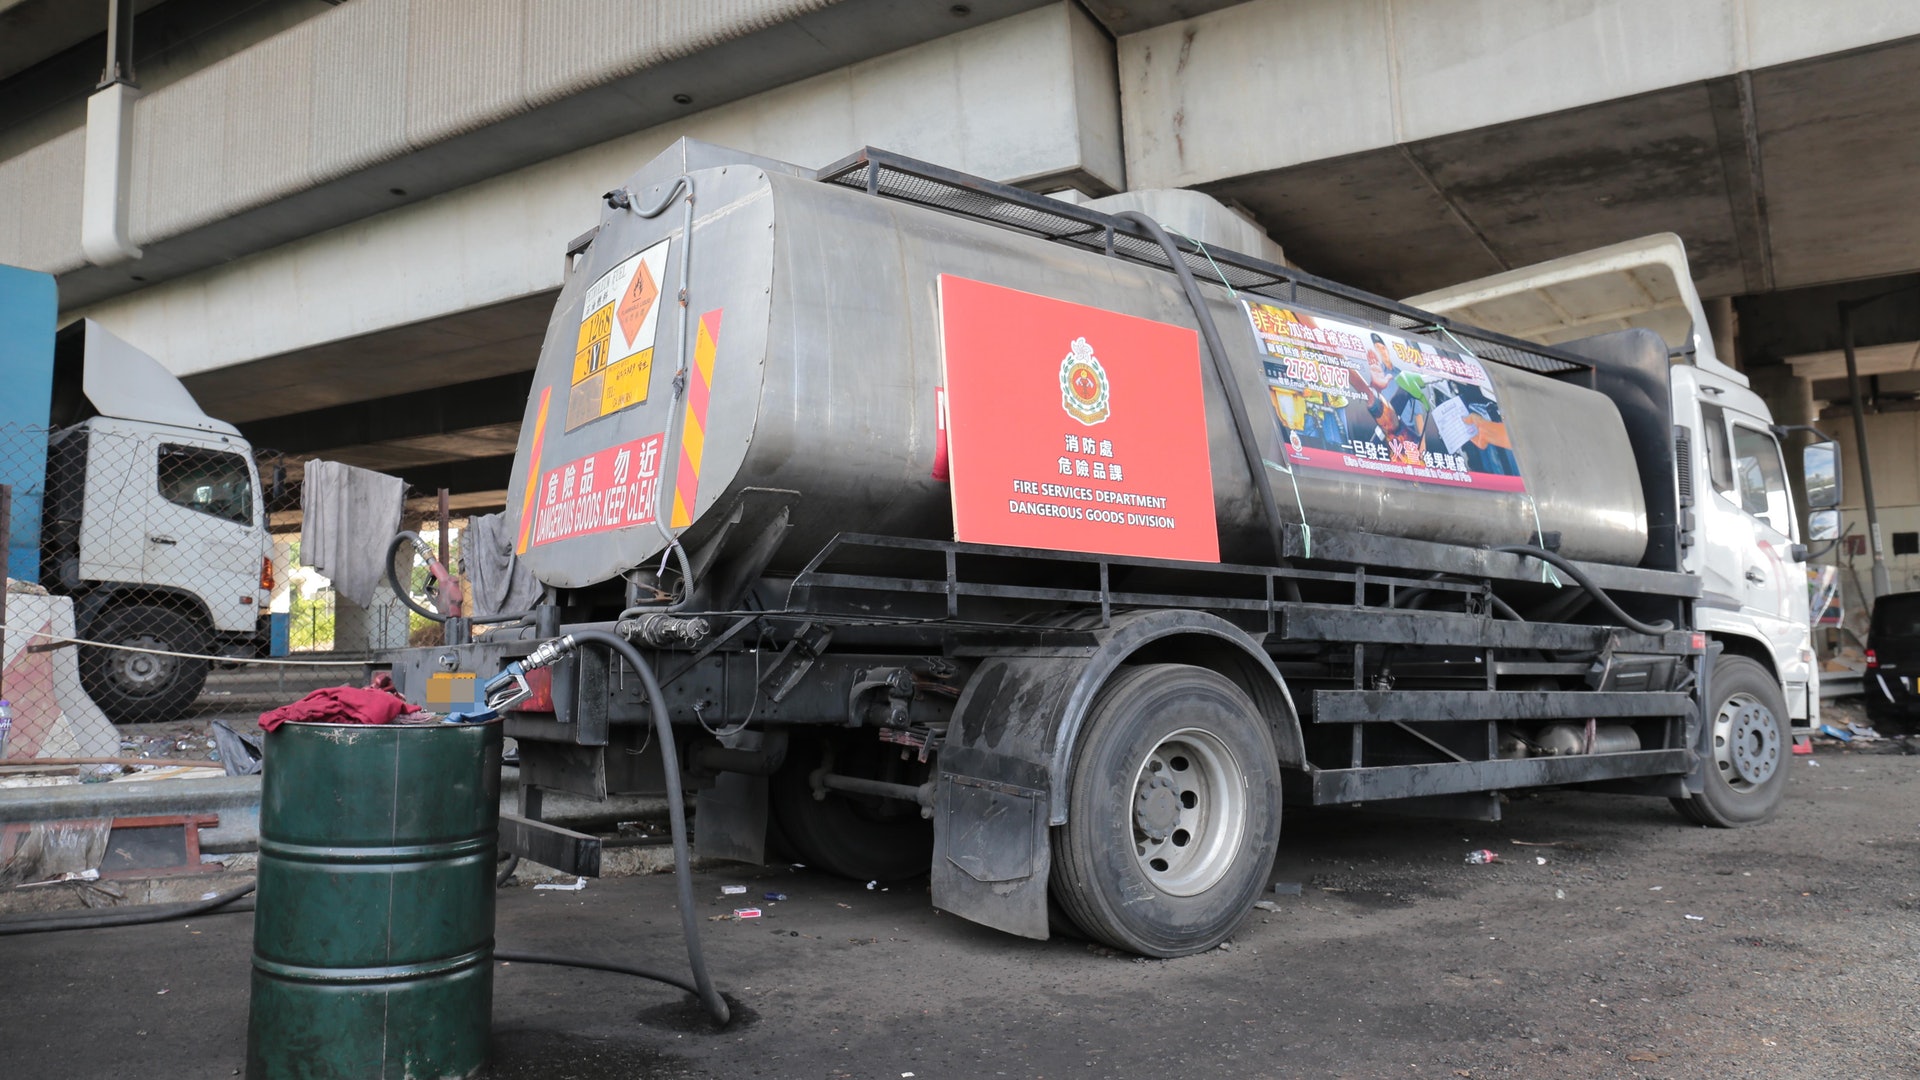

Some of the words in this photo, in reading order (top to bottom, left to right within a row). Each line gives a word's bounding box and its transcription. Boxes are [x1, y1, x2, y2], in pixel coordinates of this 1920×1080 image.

[588, 306, 612, 343] 1268
[1301, 350, 1340, 366] REPORTING
[1283, 357, 1319, 383] 2723
[1319, 364, 1350, 389] 8787
[1065, 434, 1114, 458] 消防處
[546, 457, 595, 506] 危險品
[614, 438, 658, 485] 勿近
[1057, 456, 1124, 482] 危險品課
[1013, 480, 1039, 495] FIRE
[1041, 483, 1093, 501] SERVICES
[1095, 490, 1167, 509] DEPARTMENT
[536, 499, 575, 543] DANGEROUS
[601, 485, 627, 527] KEEP
[1009, 500, 1083, 520] DANGEROUS
[1085, 508, 1125, 525] GOODS
[1127, 513, 1175, 529] DIVISION
